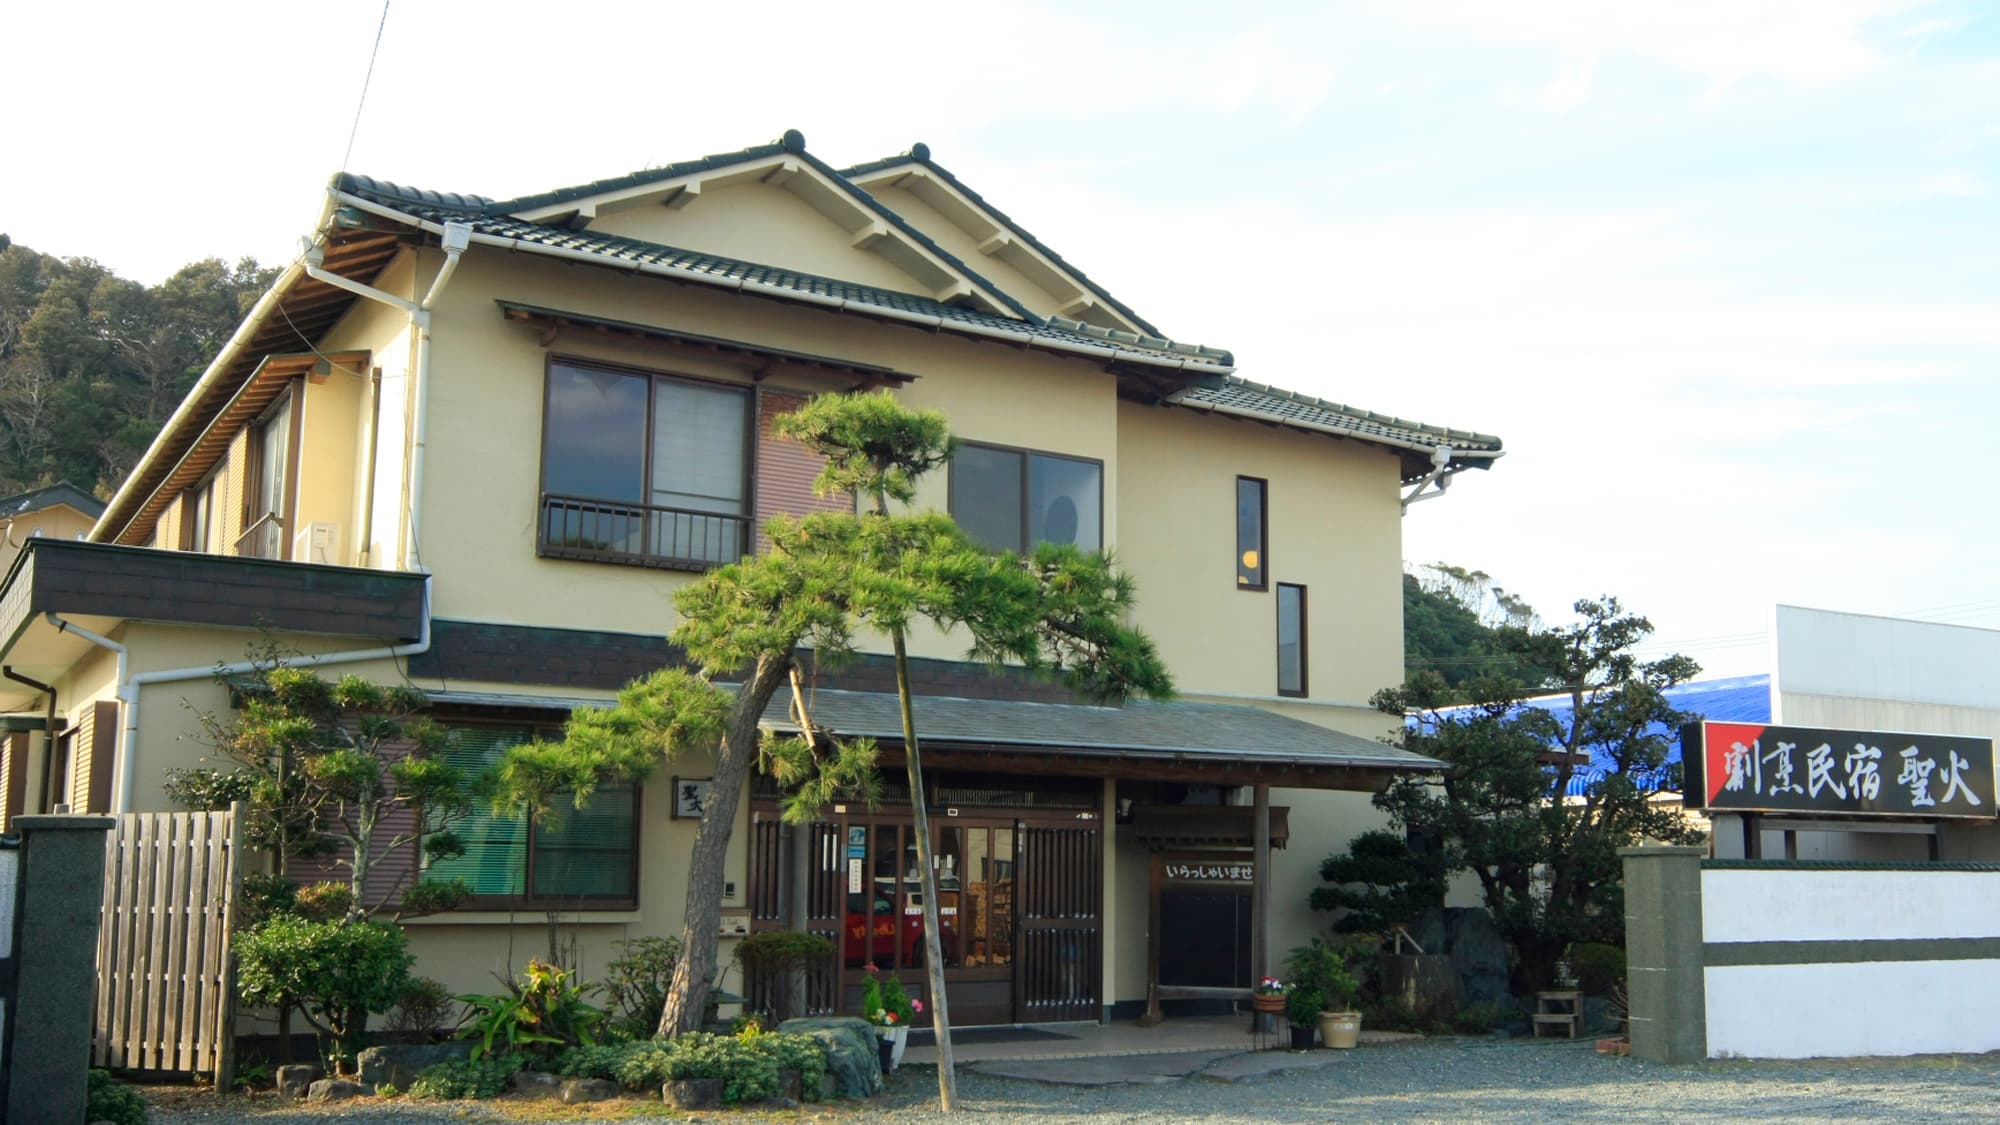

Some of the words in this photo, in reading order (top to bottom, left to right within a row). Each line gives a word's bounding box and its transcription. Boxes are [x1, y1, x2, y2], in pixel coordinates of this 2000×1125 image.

[1724, 739, 1882, 800] 割烹民宿
[1897, 745, 1981, 807] 聖火
[1166, 864, 1253, 880] いらっしゃいませ
